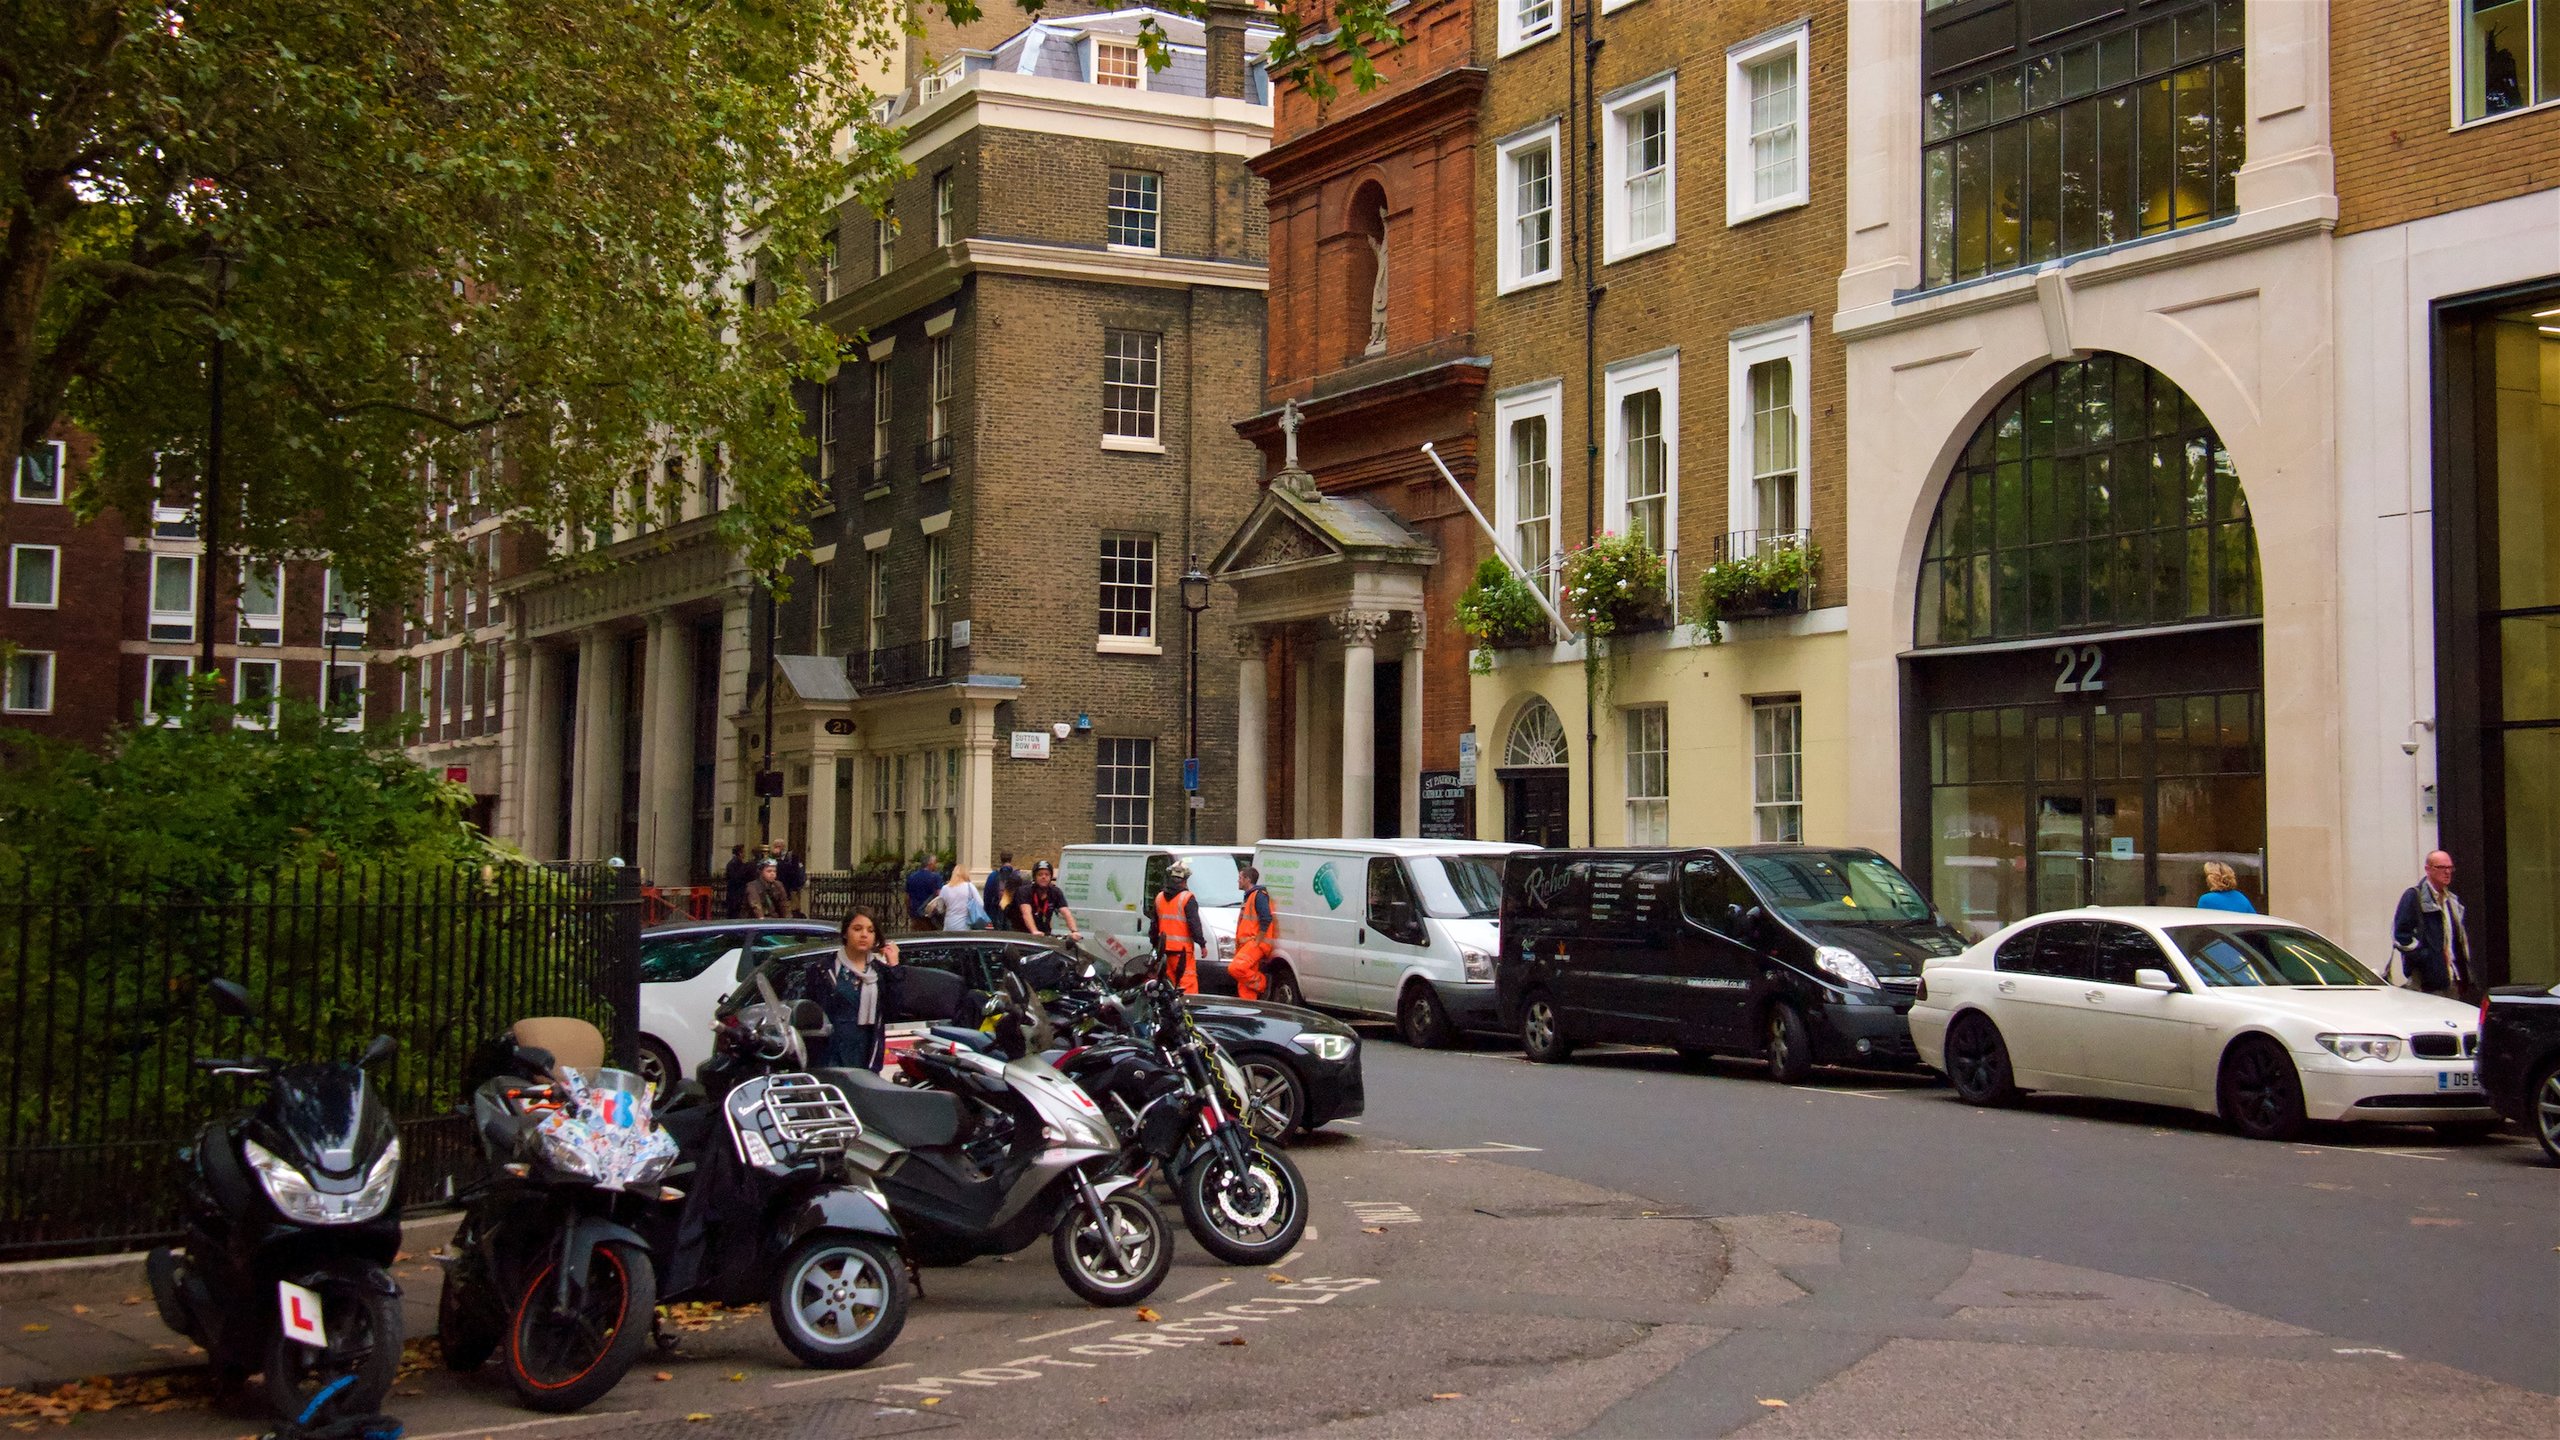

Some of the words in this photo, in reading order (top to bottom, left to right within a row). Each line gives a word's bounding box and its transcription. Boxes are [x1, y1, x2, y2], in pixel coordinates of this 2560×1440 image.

[2054, 645, 2104, 693] 22
[832, 721, 848, 733] 21
[1015, 734, 1040, 742] SUTTON
[1015, 742, 1029, 750] ROW
[1444, 788, 1465, 798] CHURCH
[291, 1295, 314, 1332] L
[879, 1276, 1381, 1395] MOTORCYCLES
